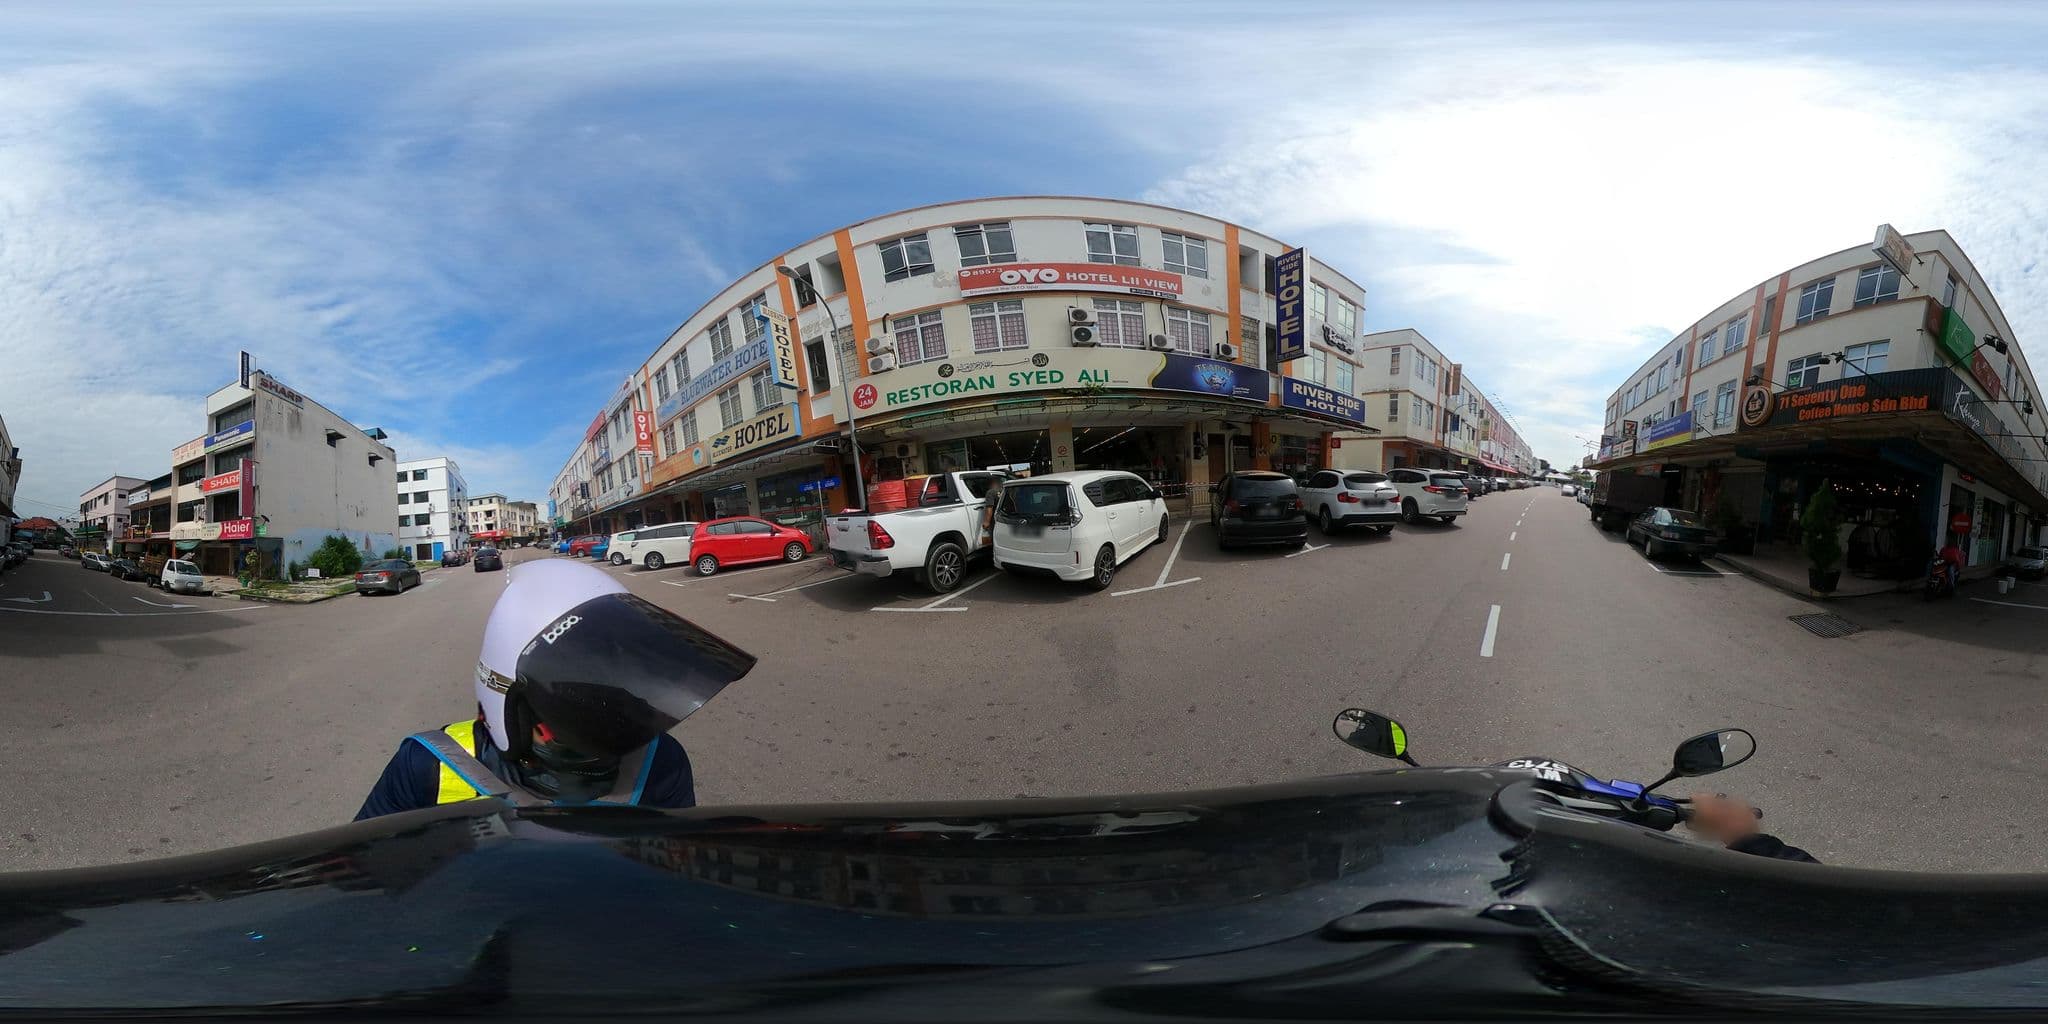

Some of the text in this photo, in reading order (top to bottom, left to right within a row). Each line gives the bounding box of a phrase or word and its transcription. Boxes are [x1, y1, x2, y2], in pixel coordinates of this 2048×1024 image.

[1278, 253, 1301, 266] RIVER
[1280, 260, 1299, 272] SIDE
[1000, 268, 1060, 284] OYO
[1065, 272, 1118, 283] HOTEL
[1144, 279, 1178, 291] VIEW
[1279, 269, 1300, 354] HOTEL
[774, 323, 794, 382] HOTEL
[681, 339, 768, 406] BLUEWATER HOTE
[1195, 364, 1234, 376] TEAPOT
[260, 378, 303, 403] SHARP
[857, 386, 872, 398] 24
[886, 369, 1109, 406] RESTORAN SYED ALI
[1292, 383, 1361, 411] RIVER SIDE
[1791, 389, 1838, 408] Seventy
[1839, 384, 1866, 400] One
[859, 398, 874, 408] JAM
[1305, 399, 1351, 416] HOTEL
[1799, 395, 1929, 421] Coffee House Sdn Bhd
[637, 414, 648, 441] OYO
[734, 413, 790, 450] HOTEL
[223, 522, 250, 534] Haier
